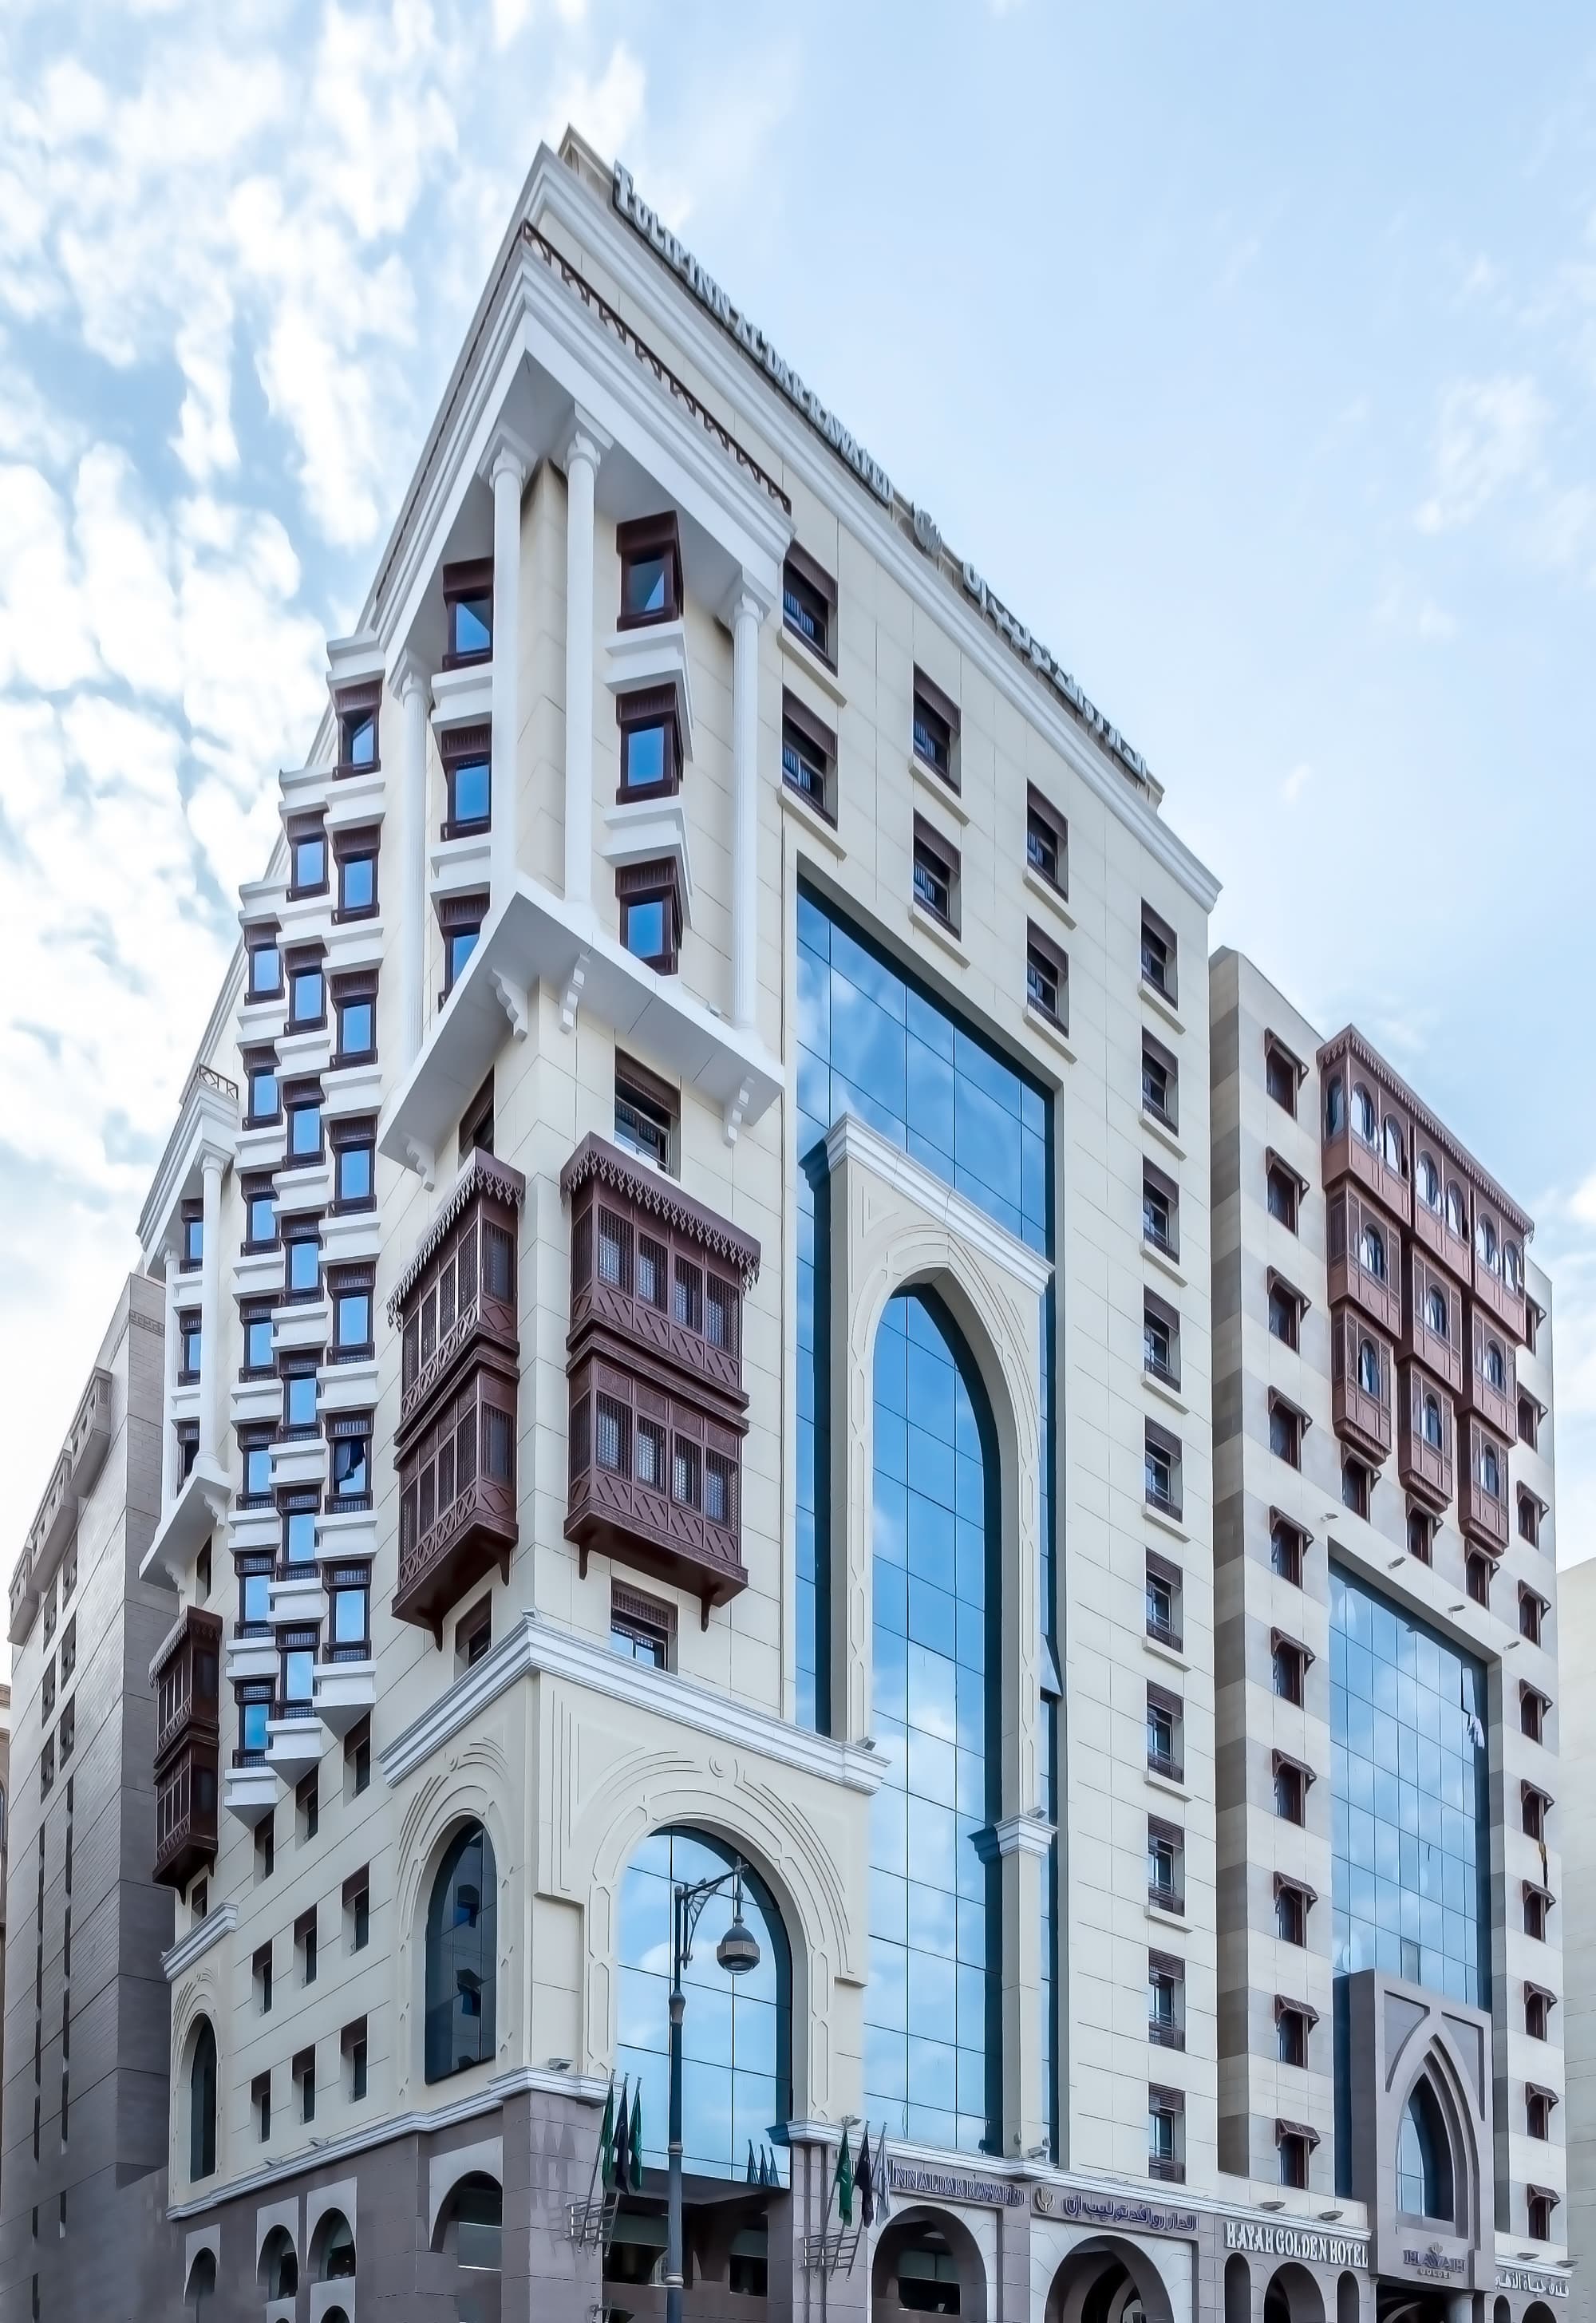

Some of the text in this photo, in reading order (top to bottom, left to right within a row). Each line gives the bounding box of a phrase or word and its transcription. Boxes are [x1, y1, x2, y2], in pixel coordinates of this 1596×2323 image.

[613, 159, 685, 270] TULIP
[687, 251, 732, 326] INN
[1225, 2222, 1369, 2268] HAYAH GOLDEN HOTEL
